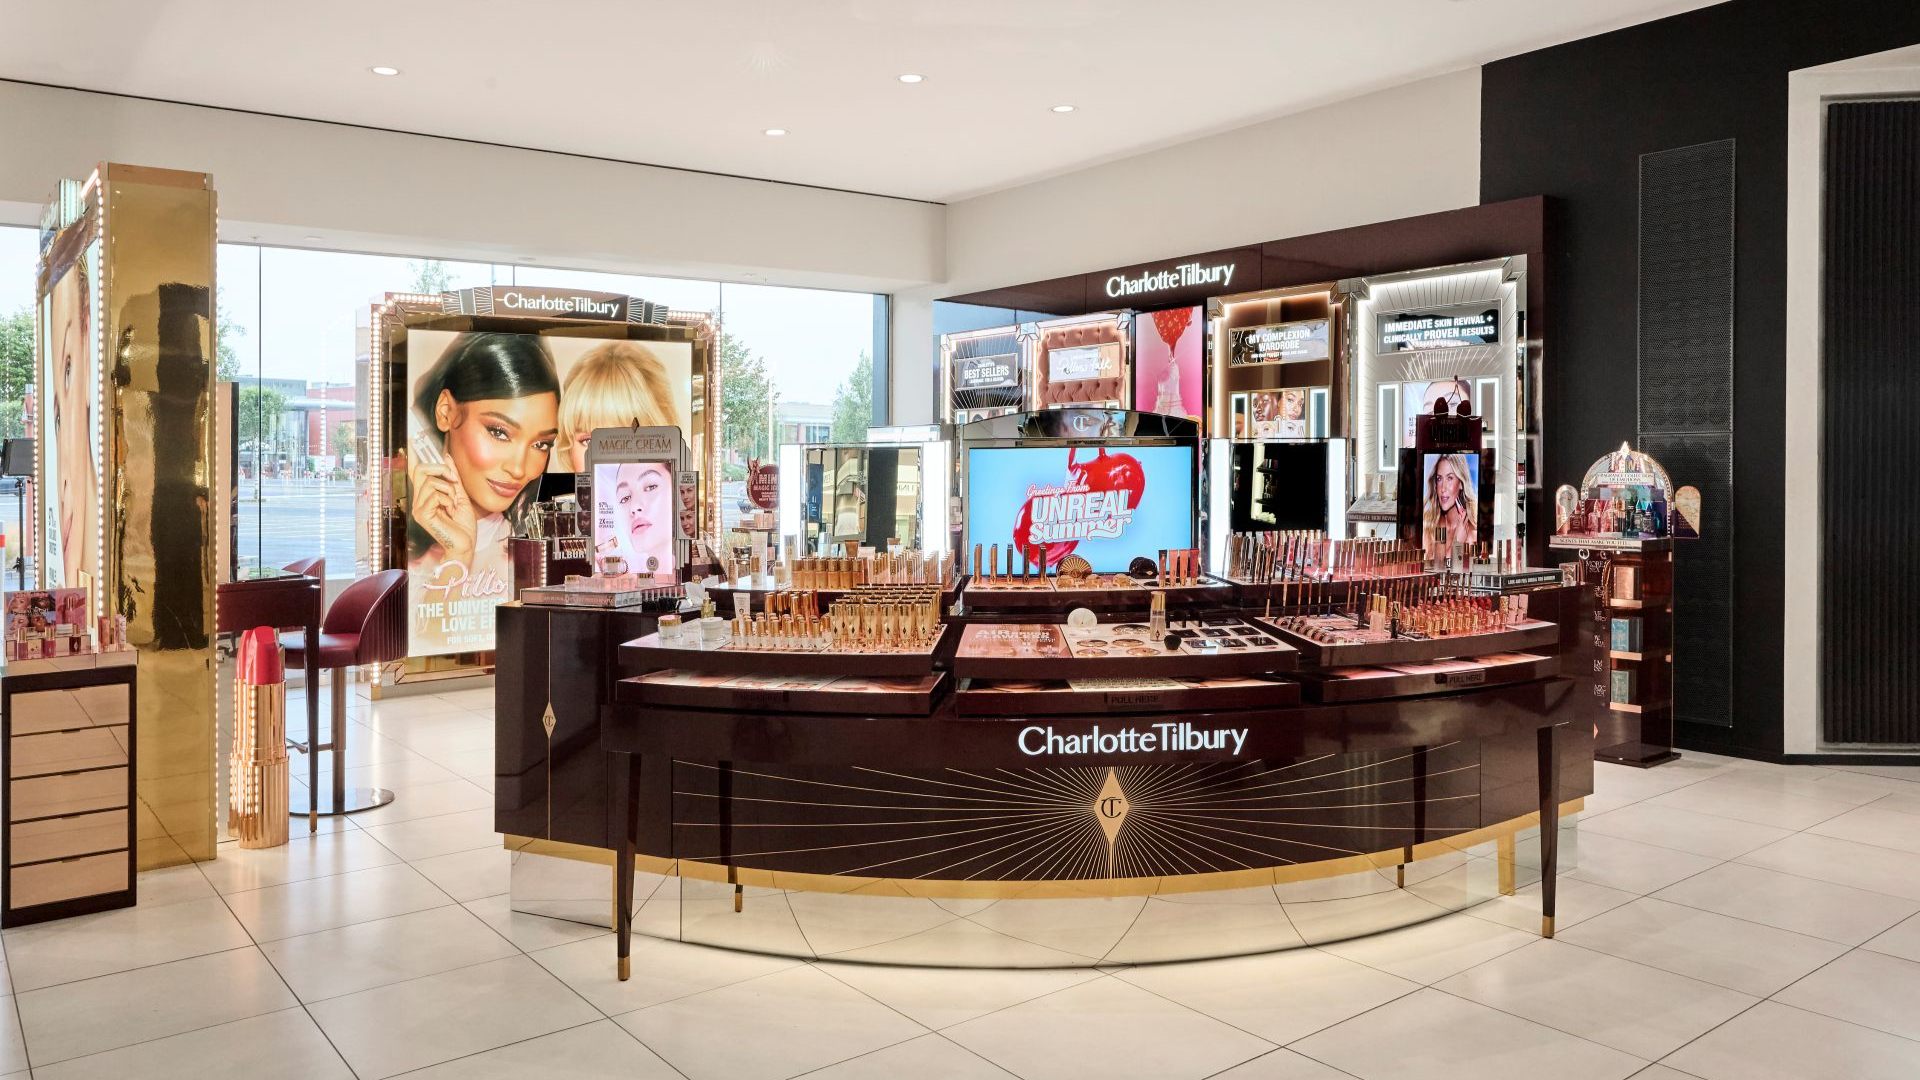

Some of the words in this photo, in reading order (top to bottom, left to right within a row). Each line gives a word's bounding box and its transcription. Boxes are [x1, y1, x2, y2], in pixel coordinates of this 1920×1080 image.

[1384, 319, 1433, 333] IMMEDIATE
[1434, 318, 1452, 328] SKIN
[1454, 315, 1485, 326] REVIVAL
[1248, 334, 1261, 344] MY
[1262, 329, 1311, 343] COMPLEXION
[1383, 332, 1423, 344] CLINICALLY
[1424, 328, 1460, 341] PROVEN
[1461, 326, 1495, 337] RESULTS
[1258, 340, 1300, 352] WARDROBE
[964, 368, 981, 380] BEST
[981, 365, 1010, 378] SELLERS
[599, 438, 633, 451] MAGIC
[635, 438, 672, 451] CREAM
[1026, 484, 1065, 499] Greetings
[1067, 480, 1091, 493] From
[1030, 489, 1133, 524] UNREAL
[553, 551, 587, 560] TILBUR
[421, 560, 507, 599] Pillo
[417, 602, 445, 618] THE
[448, 599, 496, 616] UNIVER
[441, 616, 476, 632] LOVE
